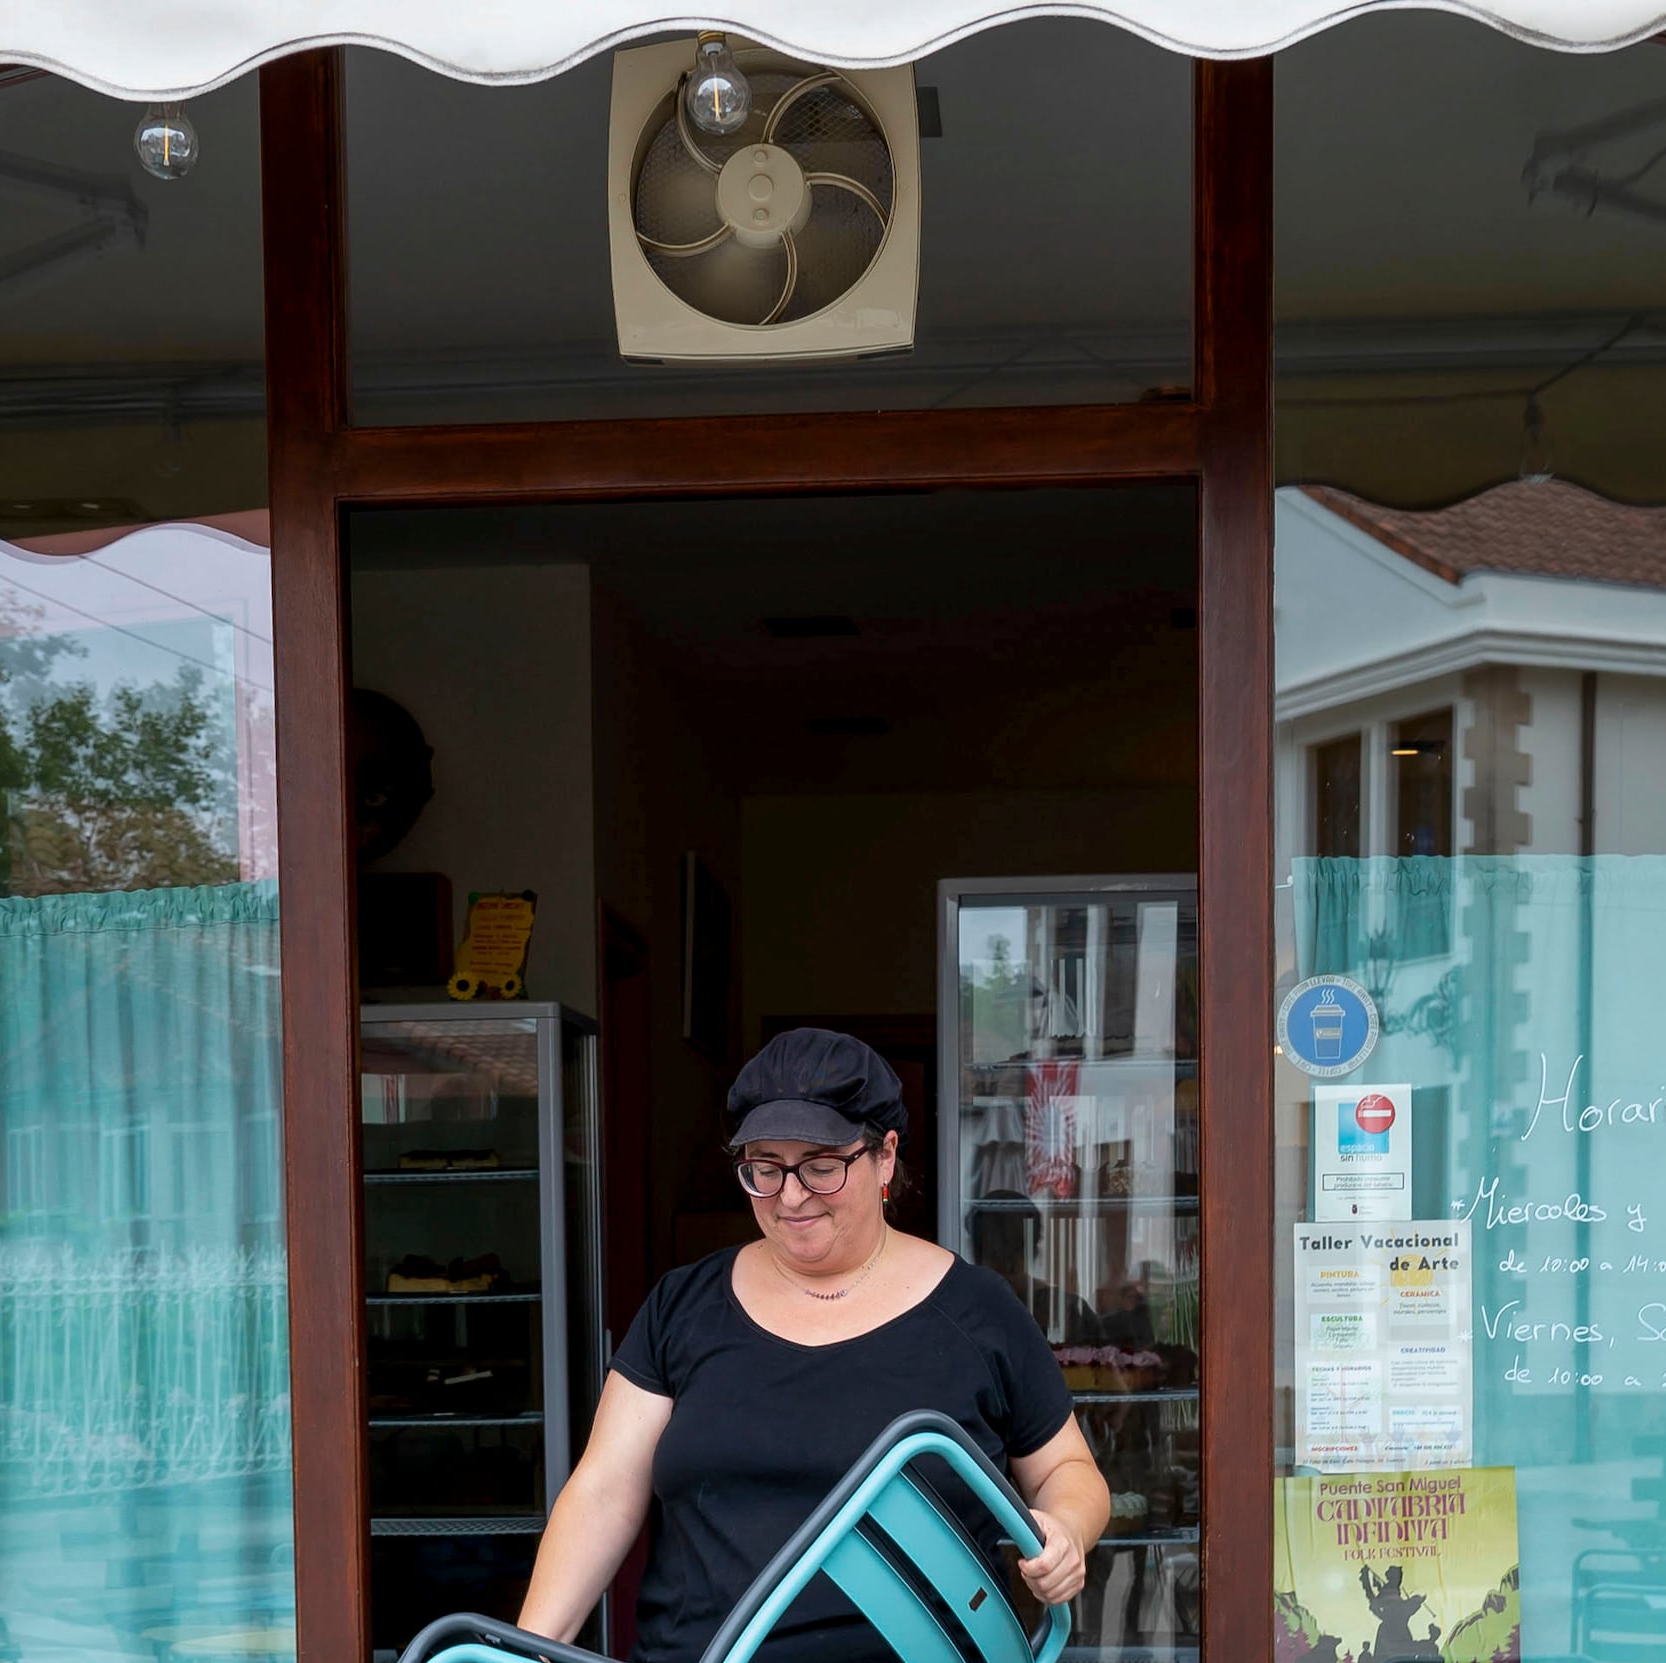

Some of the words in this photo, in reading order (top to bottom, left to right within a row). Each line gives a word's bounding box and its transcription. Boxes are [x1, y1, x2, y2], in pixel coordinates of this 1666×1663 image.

[1340, 1143, 1375, 1153] espacio
[1340, 1154, 1354, 1162] sin
[1355, 1153, 1383, 1161] humo
[1627, 1204, 1647, 1232] y
[1299, 1236, 1352, 1250] Taller
[1360, 1232, 1459, 1249] Vacacional
[1389, 1256, 1410, 1271] de
[1418, 1256, 1460, 1271] Arte
[1499, 1249, 1527, 1273] de
[1600, 1262, 1613, 1270] a
[1320, 1271, 1359, 1279] PINTURA
[1321, 1315, 1363, 1323] ESCULTURA
[1480, 1300, 1616, 1348] Viernes,
[1504, 1356, 1531, 1383] de
[1547, 1366, 1604, 1386] 10:00
[1625, 1374, 1642, 1386] a
[1320, 1481, 1372, 1497] Puente
[1376, 1479, 1405, 1493] San
[1409, 1476, 1462, 1494] Miguel
[1316, 1493, 1466, 1522] CANTABRIA
[1336, 1518, 1448, 1546] INFINITA
[1344, 1548, 1376, 1561] FOLK
[1377, 1546, 1439, 1560] FESTIVAL
